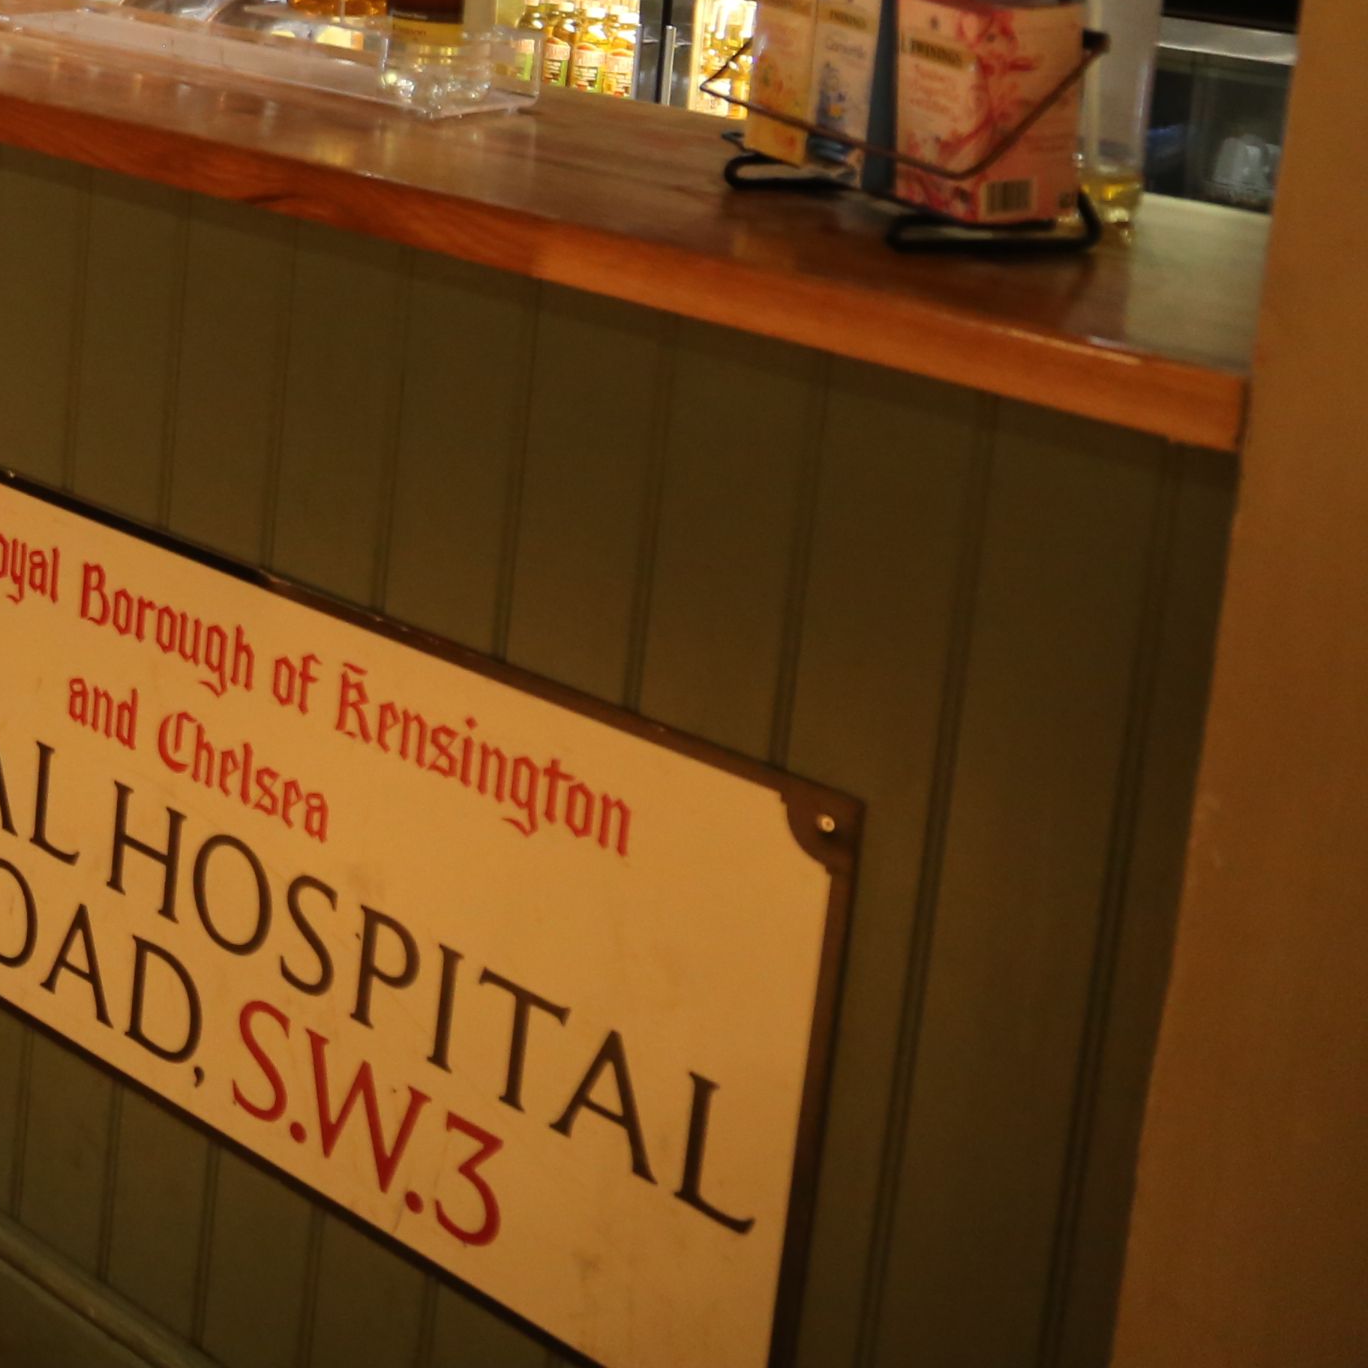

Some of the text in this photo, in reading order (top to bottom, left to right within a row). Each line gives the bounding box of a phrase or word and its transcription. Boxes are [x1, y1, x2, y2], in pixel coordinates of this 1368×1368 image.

[67, 673, 330, 843] and Chelsea
[78, 560, 255, 698] Borough
[270, 653, 322, 718] of
[335, 662, 633, 858] Kensington
[105, 779, 758, 1236] HOSPITAL
[230, 998, 504, 1248] S.W.3
